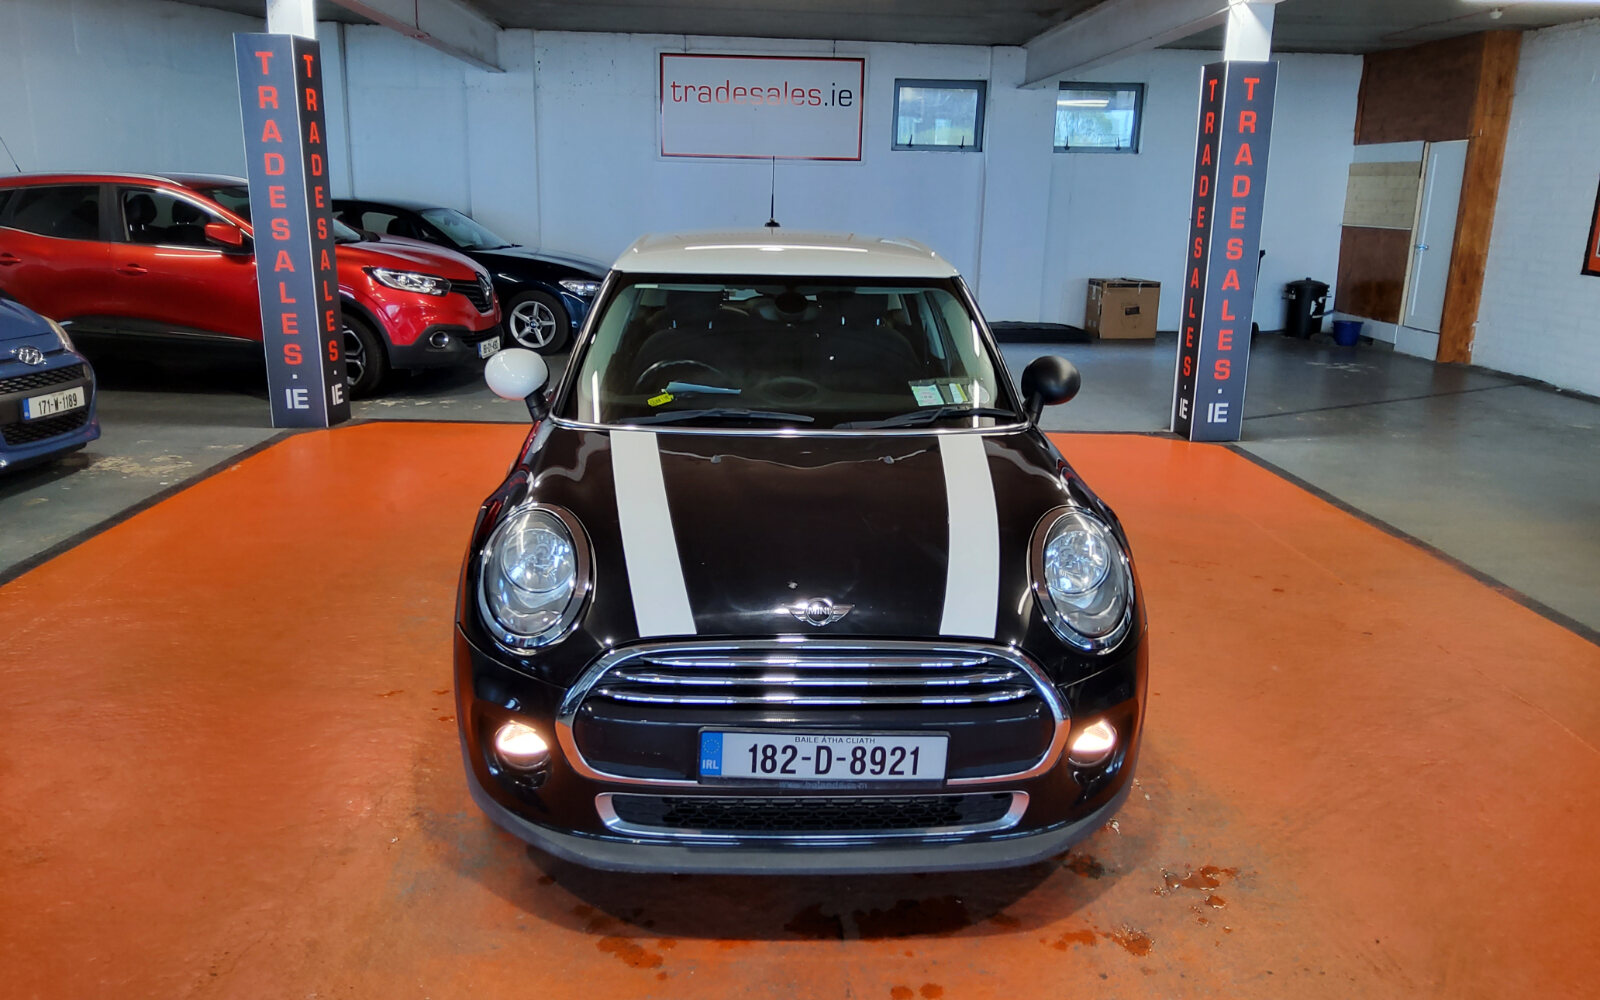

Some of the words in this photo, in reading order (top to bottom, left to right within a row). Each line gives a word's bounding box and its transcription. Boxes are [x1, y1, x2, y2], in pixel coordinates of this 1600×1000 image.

[670, 79, 853, 107] tradesales.ie
[39, 392, 78, 415] 171-W-1189
[808, 606, 830, 615] MINI
[702, 759, 719, 770] IRL
[748, 743, 920, 776] 182-D-8921
